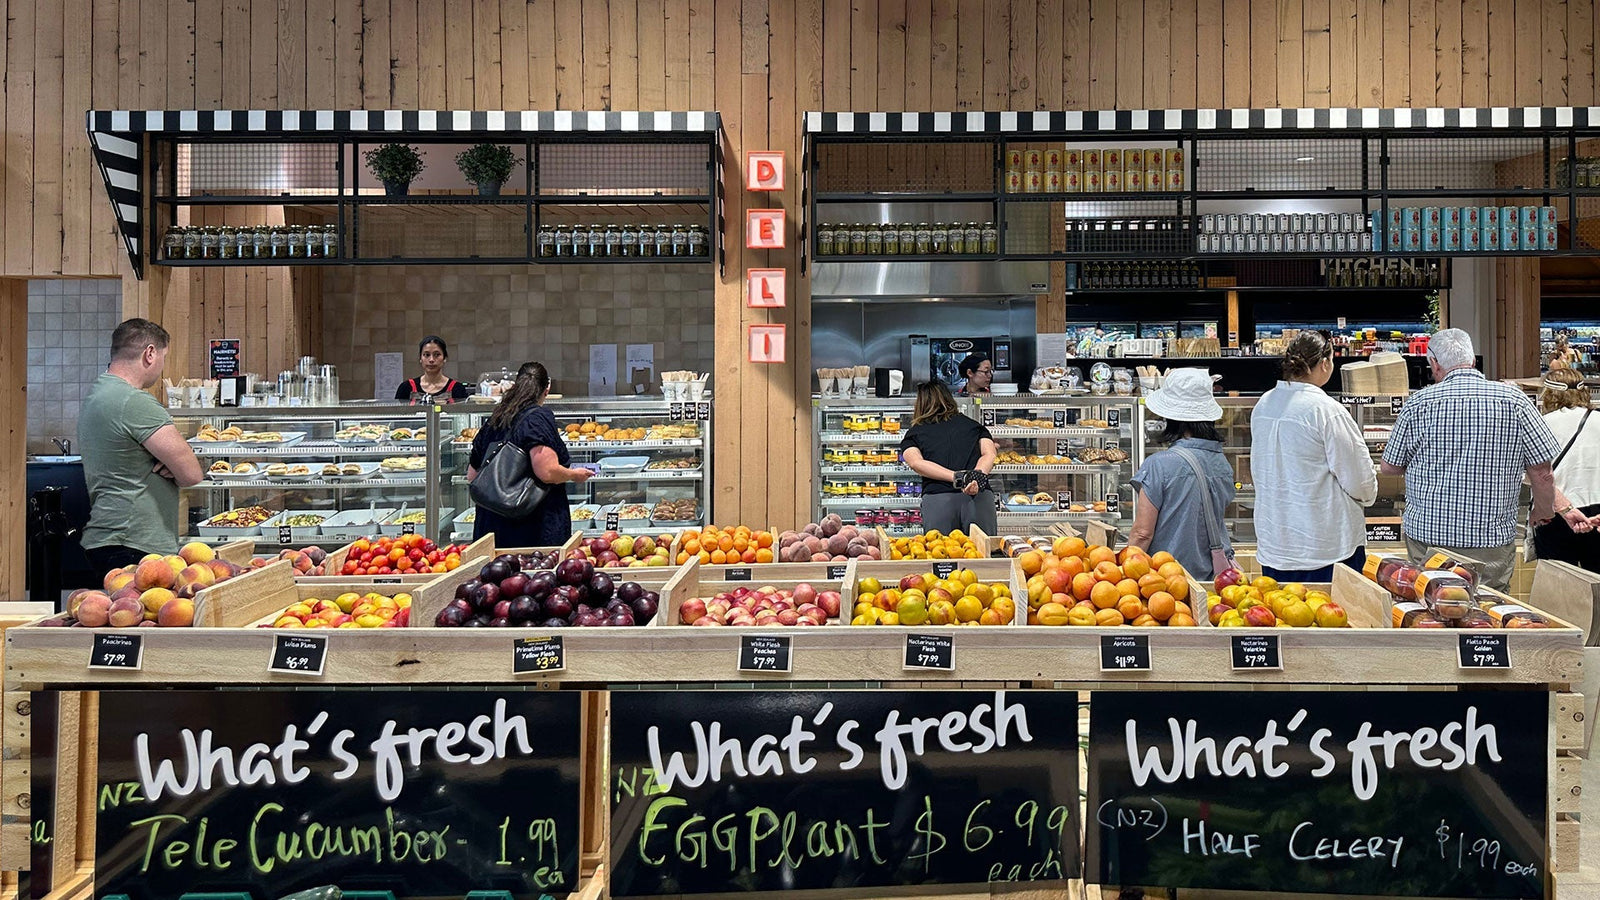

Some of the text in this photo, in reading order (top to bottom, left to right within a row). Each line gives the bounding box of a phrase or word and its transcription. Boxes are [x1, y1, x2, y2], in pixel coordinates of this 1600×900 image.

[908, 638, 936, 646] Nectarines
[516, 645, 544, 653] Primetime
[103, 653, 126, 666] $7.99
[286, 656, 309, 669] $6.99
[521, 652, 540, 660] Yellow
[536, 656, 559, 669] $3.99
[753, 656, 775, 669] $7.99
[917, 653, 939, 666] $7.99
[1115, 655, 1136, 668] $11.99
[1245, 654, 1266, 667] $7.99
[1473, 654, 1495, 667] $7.99
[647, 691, 1033, 793] What's fresh
[137, 698, 534, 800] What's fresh
[1126, 706, 1502, 800] What's fresh
[616, 766, 669, 803] NZ
[100, 782, 145, 810] NZ
[1182, 818, 1260, 857] HALF
[1289, 822, 1404, 869] CELERY
[1505, 861, 1537, 877] each
[988, 849, 1063, 883] each
